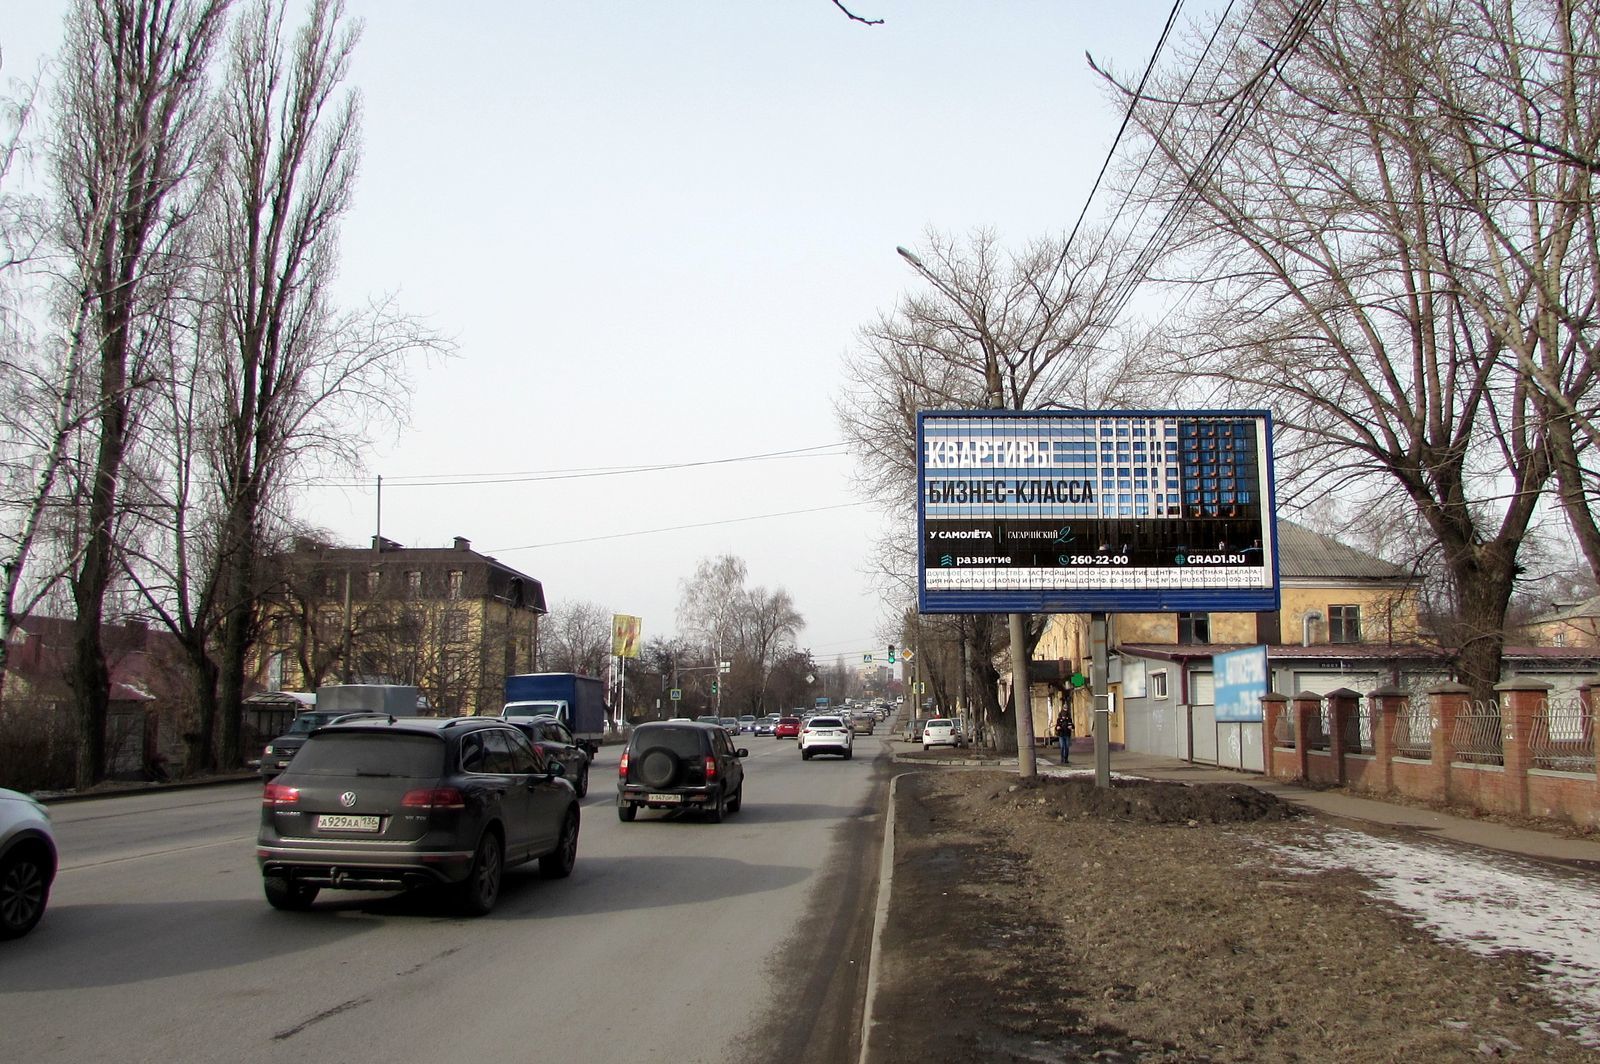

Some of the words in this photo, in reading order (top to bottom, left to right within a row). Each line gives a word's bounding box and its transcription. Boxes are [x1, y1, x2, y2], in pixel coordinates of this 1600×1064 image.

[928, 441, 1054, 468] КВАРТИРЫ
[929, 480, 1094, 504] БИЗНЕС-КЛАССА
[929, 531, 938, 540] У
[938, 529, 993, 539] САМОЛЁТА
[956, 554, 1012, 567] развитие
[1070, 554, 1129, 565] 260-22-00
[1187, 554, 1246, 565] GRAD1.RU
